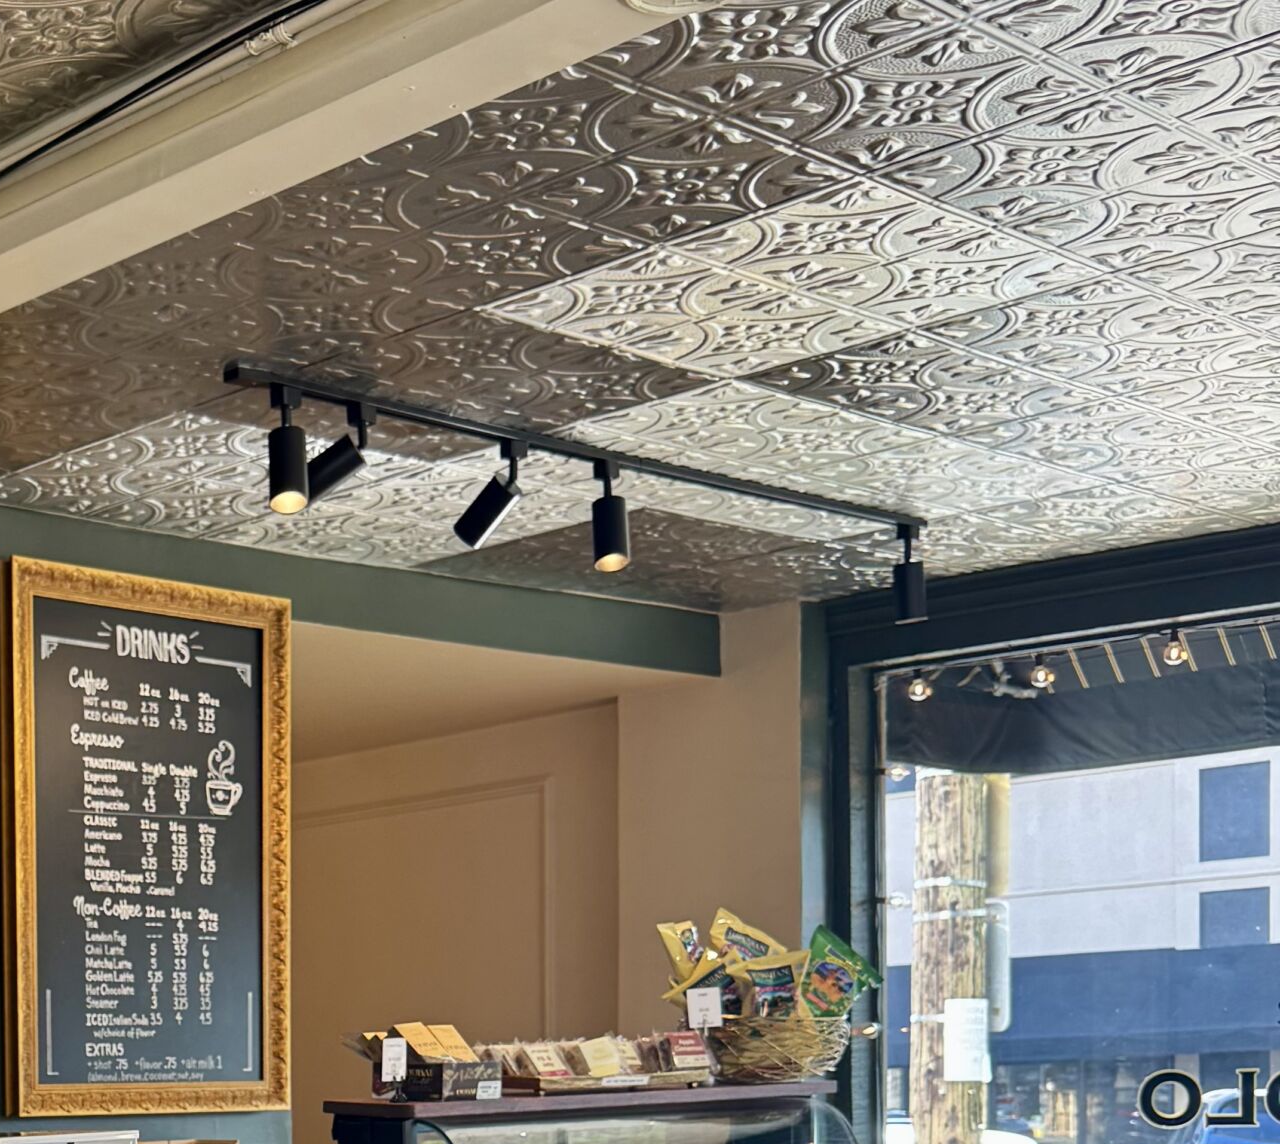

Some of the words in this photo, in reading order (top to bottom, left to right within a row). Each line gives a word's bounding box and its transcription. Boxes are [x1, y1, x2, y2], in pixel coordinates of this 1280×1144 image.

[116, 624, 191, 664] DRINKS
[69, 666, 109, 696] Coffee
[174, 704, 181, 717] 3
[70, 723, 124, 750] Espresso
[84, 829, 122, 841] Americano
[146, 844, 153, 856] 5
[85, 868, 120, 882] BLENDED
[176, 872, 183, 884] 6
[73, 896, 142, 920] Non-Coffee
[150, 943, 156, 956] 5
[202, 944, 209, 957] 6
[151, 958, 157, 969] 5
[85, 970, 113, 983] Golden
[85, 984, 100, 996] Hot
[86, 1013, 108, 1026] ICED
[85, 1042, 124, 1057] EXTRAS
